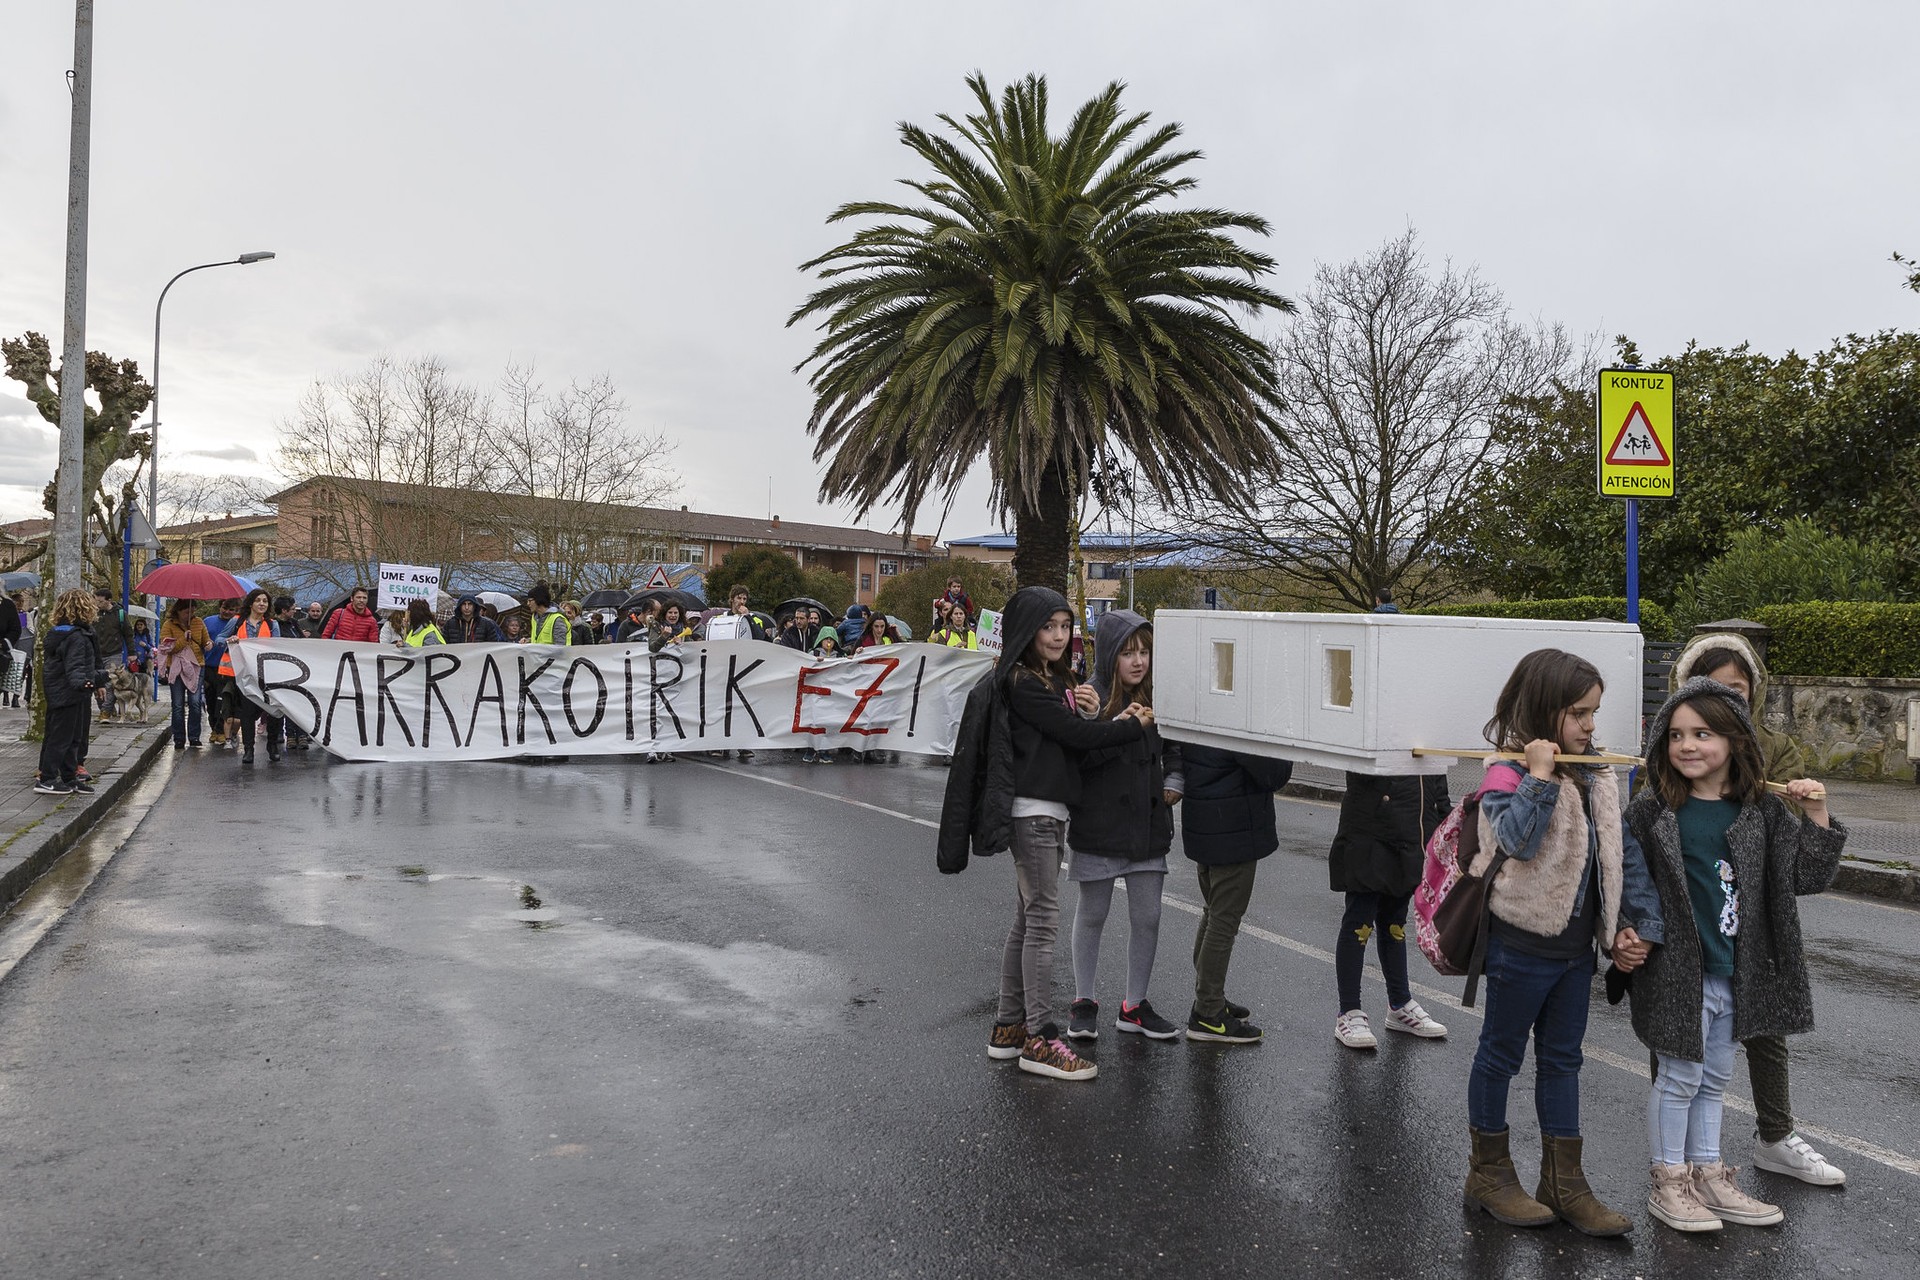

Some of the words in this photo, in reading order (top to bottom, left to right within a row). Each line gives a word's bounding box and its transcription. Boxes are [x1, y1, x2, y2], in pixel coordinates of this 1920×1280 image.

[1611, 377, 1664, 390] KONTUZ
[1605, 475, 1670, 489] ATENCIÓN
[381, 571, 405, 581] UME
[411, 574, 438, 584] ASKO
[388, 584, 429, 595] ESKOLA
